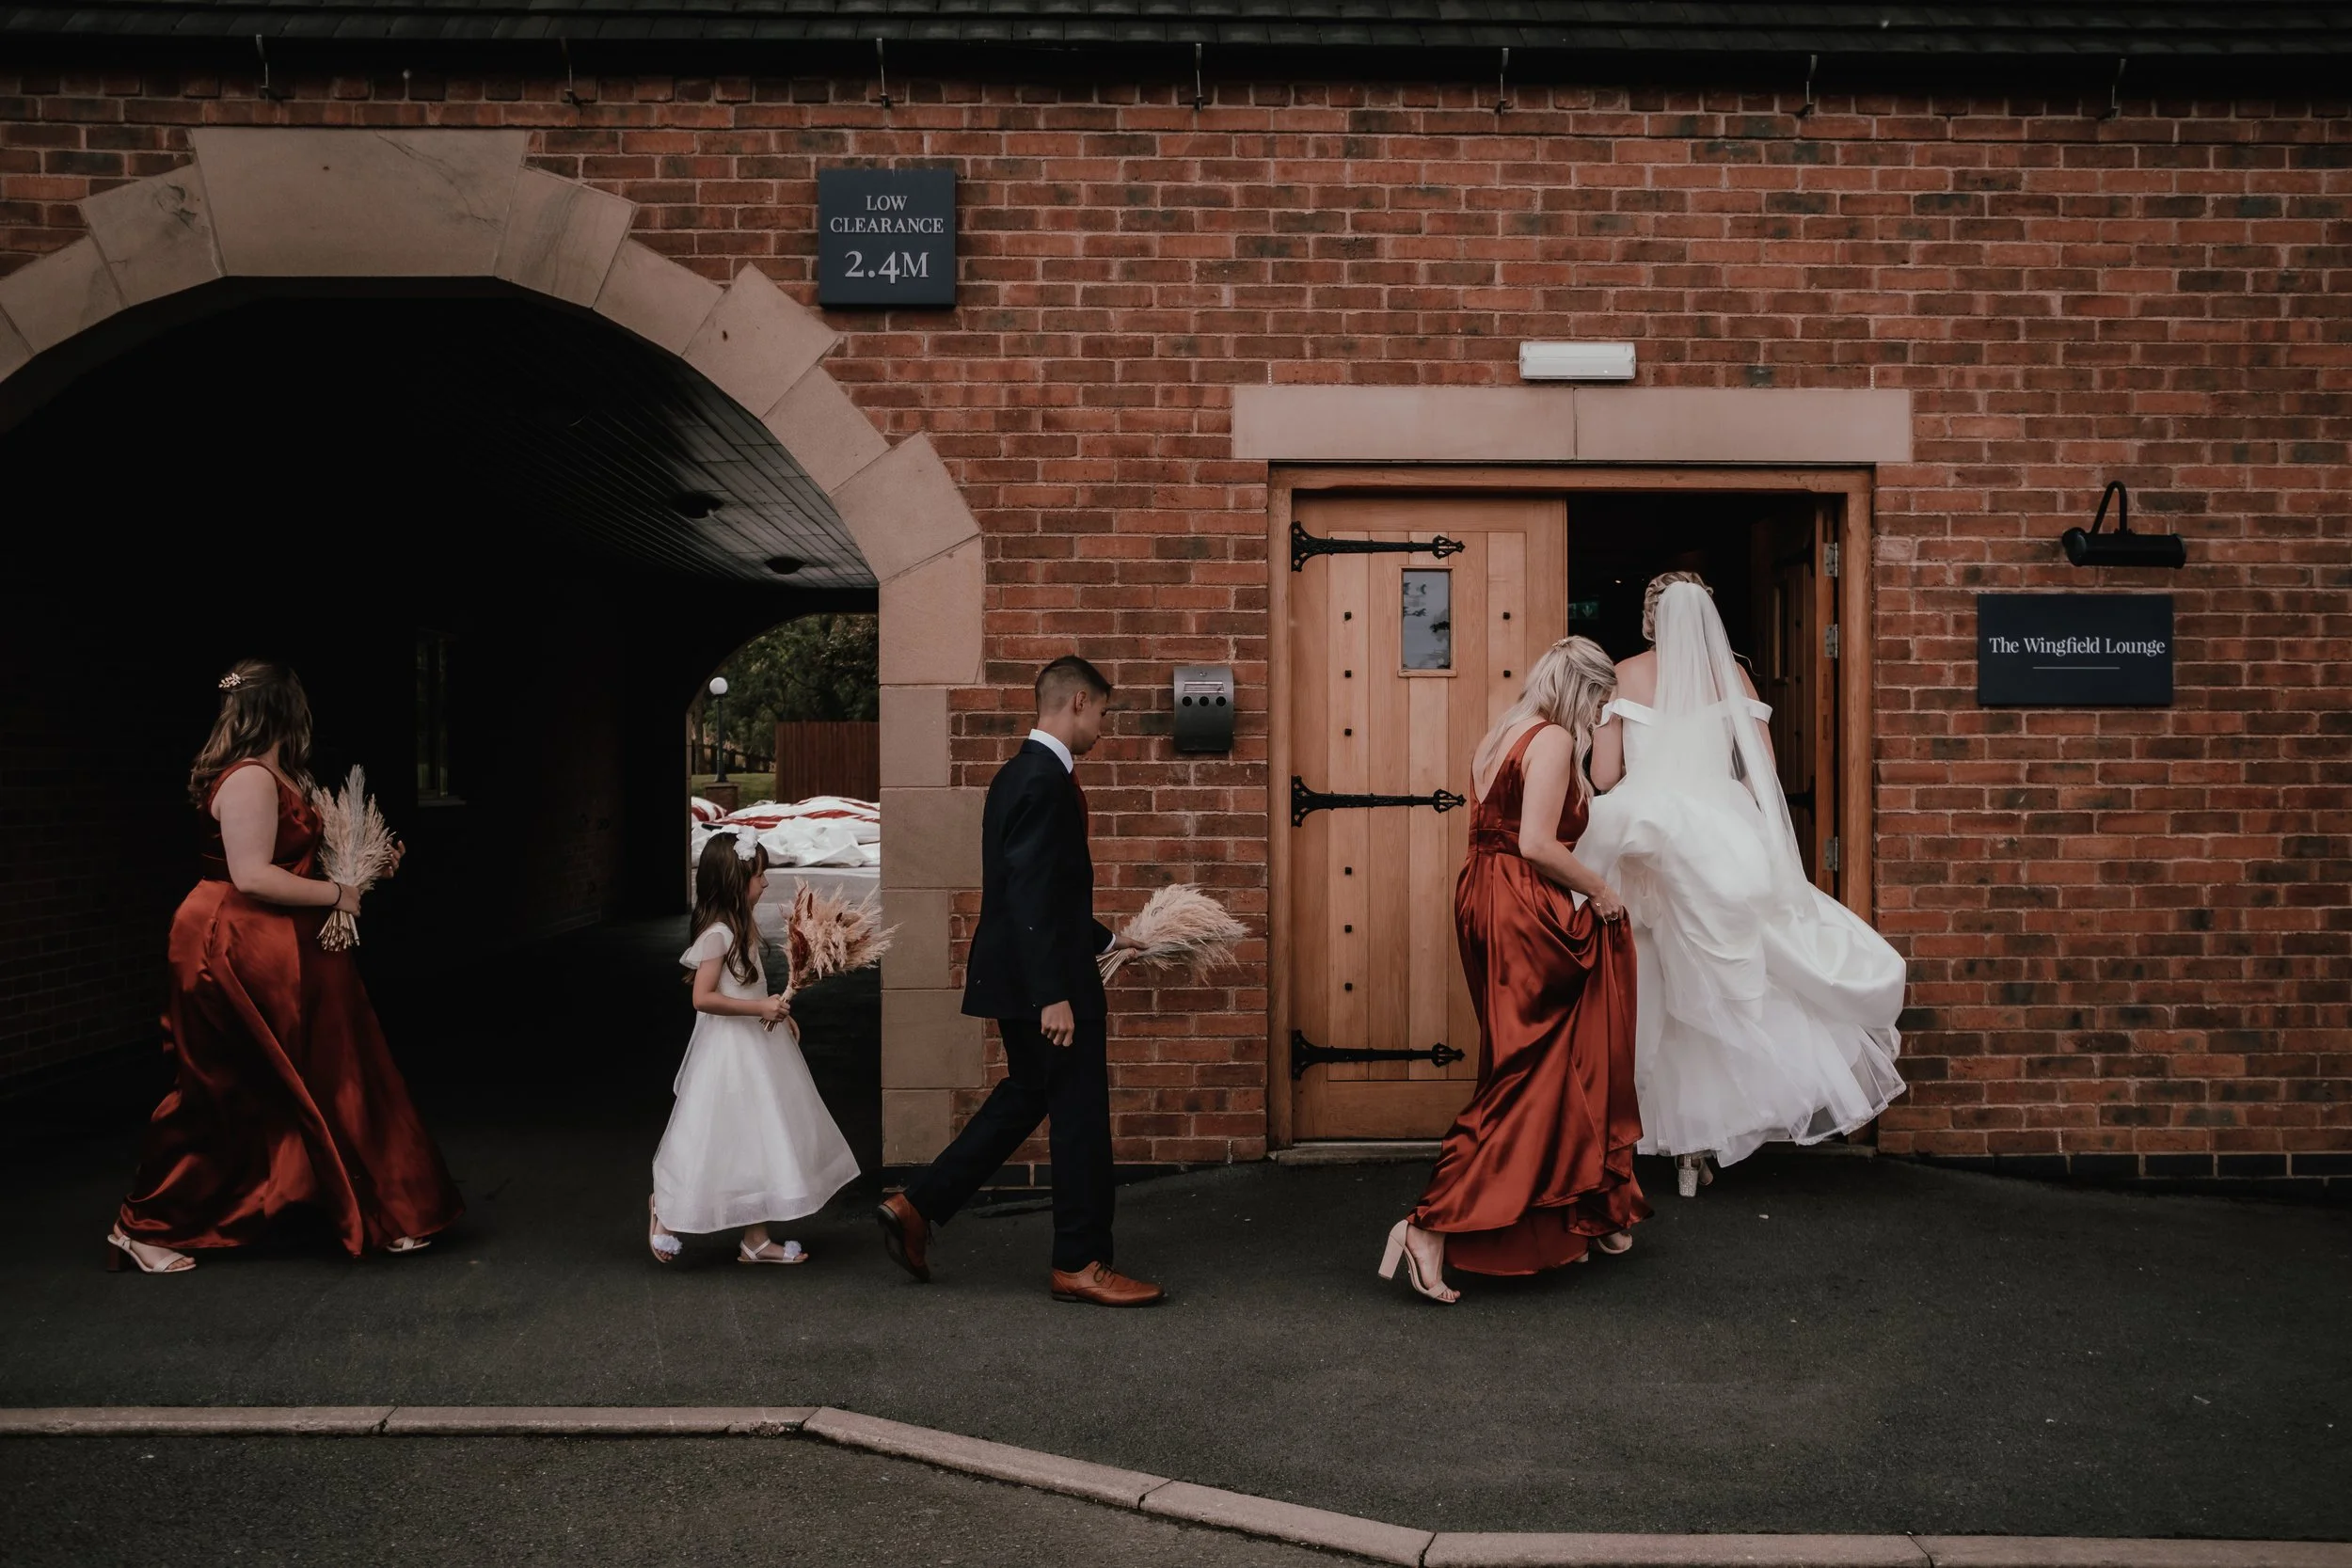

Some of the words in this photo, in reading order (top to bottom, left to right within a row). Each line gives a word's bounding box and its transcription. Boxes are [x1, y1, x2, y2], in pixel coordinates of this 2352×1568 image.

[866, 195, 908, 212] LOW
[830, 217, 945, 233] CLEARANCE
[845, 250, 930, 284] 2.4M
[1989, 636, 2020, 654] The
[2024, 636, 2101, 657] Wingfield
[2106, 638, 2166, 657] Lounge
